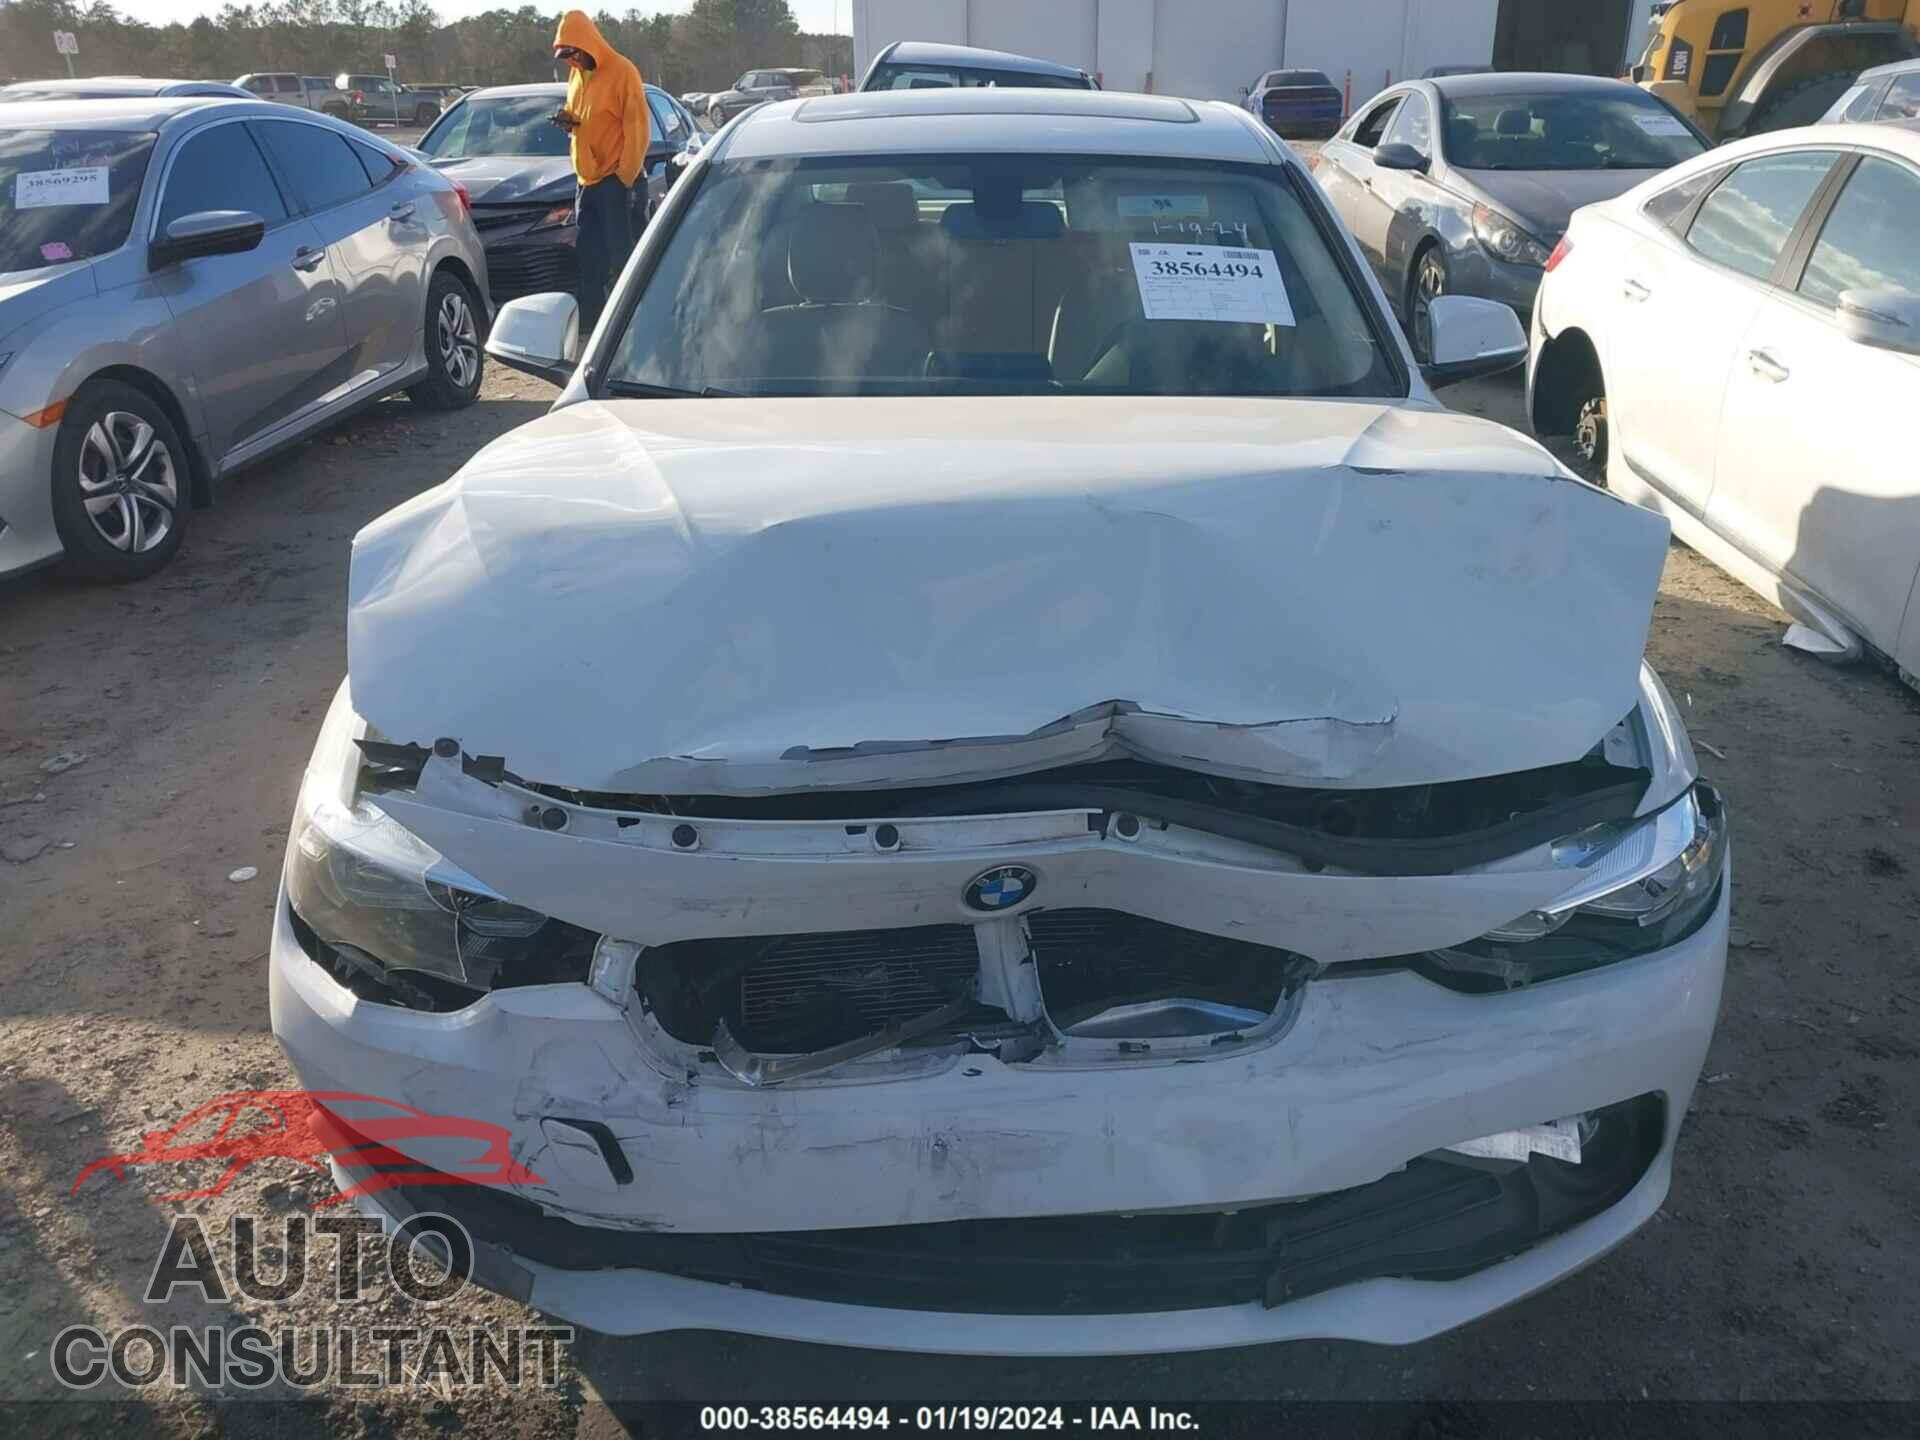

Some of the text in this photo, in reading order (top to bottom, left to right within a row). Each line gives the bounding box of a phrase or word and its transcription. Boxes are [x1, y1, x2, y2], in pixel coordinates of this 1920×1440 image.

[1672, 51, 1689, 75] L90H
[1152, 219, 1248, 240] 1-19-24
[1151, 261, 1263, 278] 38564494
